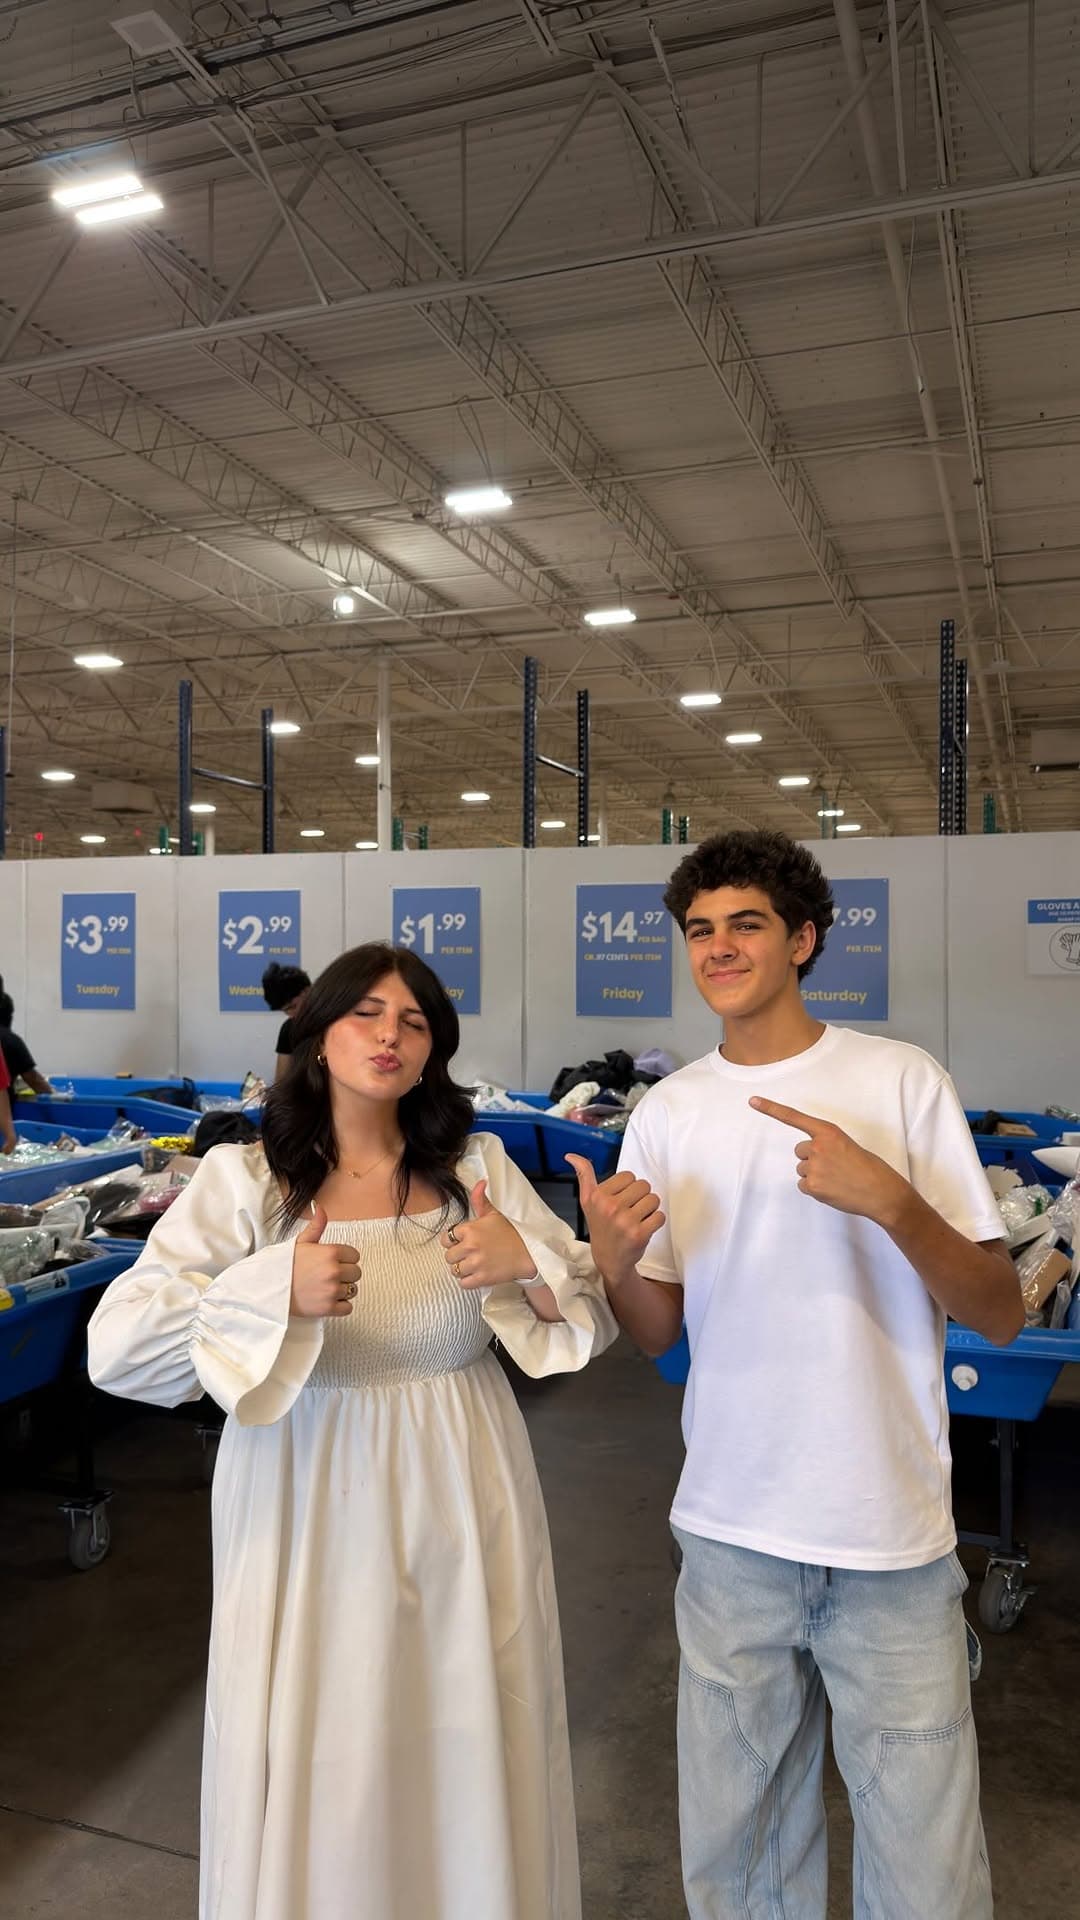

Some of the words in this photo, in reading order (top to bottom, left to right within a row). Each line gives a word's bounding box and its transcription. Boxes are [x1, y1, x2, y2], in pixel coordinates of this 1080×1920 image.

[1037, 902, 1071, 911] GLOVES
[64, 915, 128, 954] $3.99
[222, 915, 292, 954] $2.99
[399, 913, 466, 954] $1.99
[76, 983, 119, 997] Tuesday
[228, 984, 265, 996] Wedne
[602, 987, 644, 1002] Friday
[800, 990, 867, 1004] Saturday
